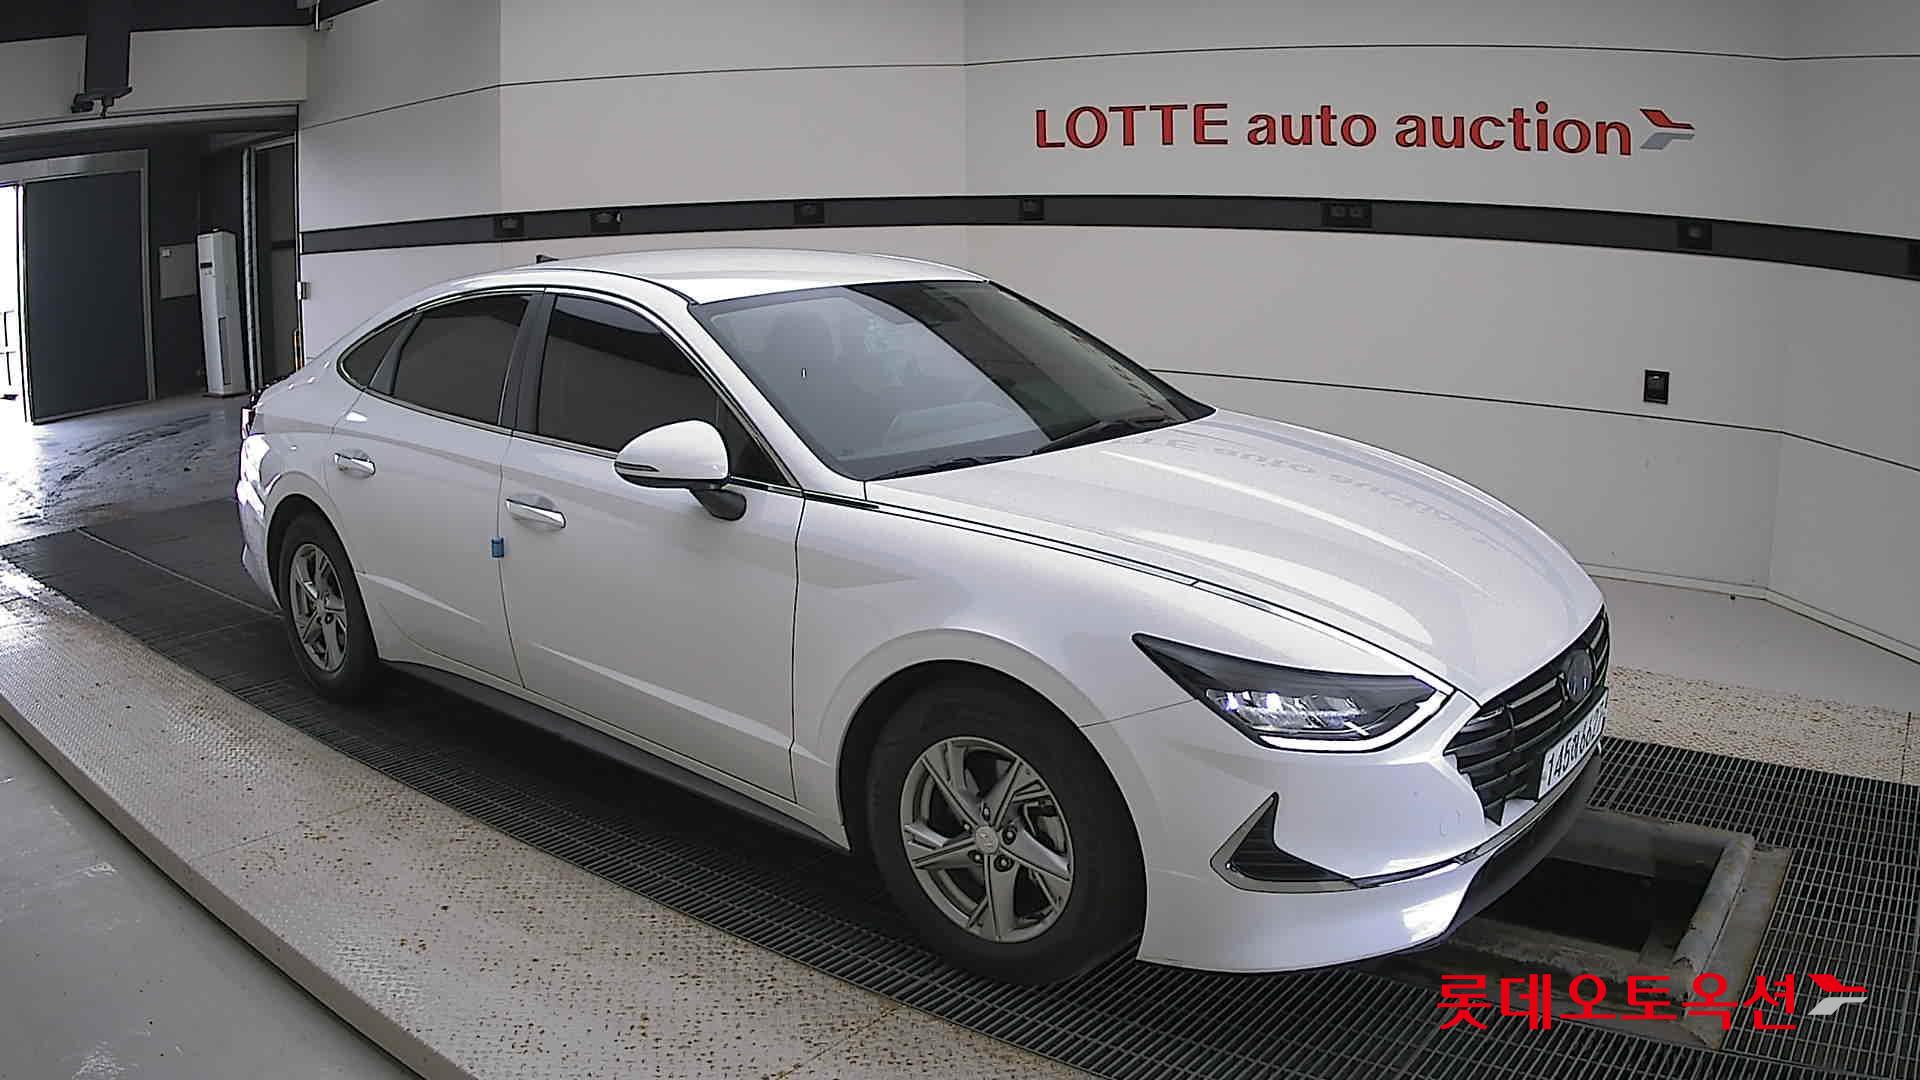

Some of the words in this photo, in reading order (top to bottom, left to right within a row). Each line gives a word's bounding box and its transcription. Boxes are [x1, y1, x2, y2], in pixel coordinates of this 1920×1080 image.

[1035, 102, 1229, 149] LOTTE
[1246, 104, 1378, 146] auto
[1394, 101, 1633, 157] auction
